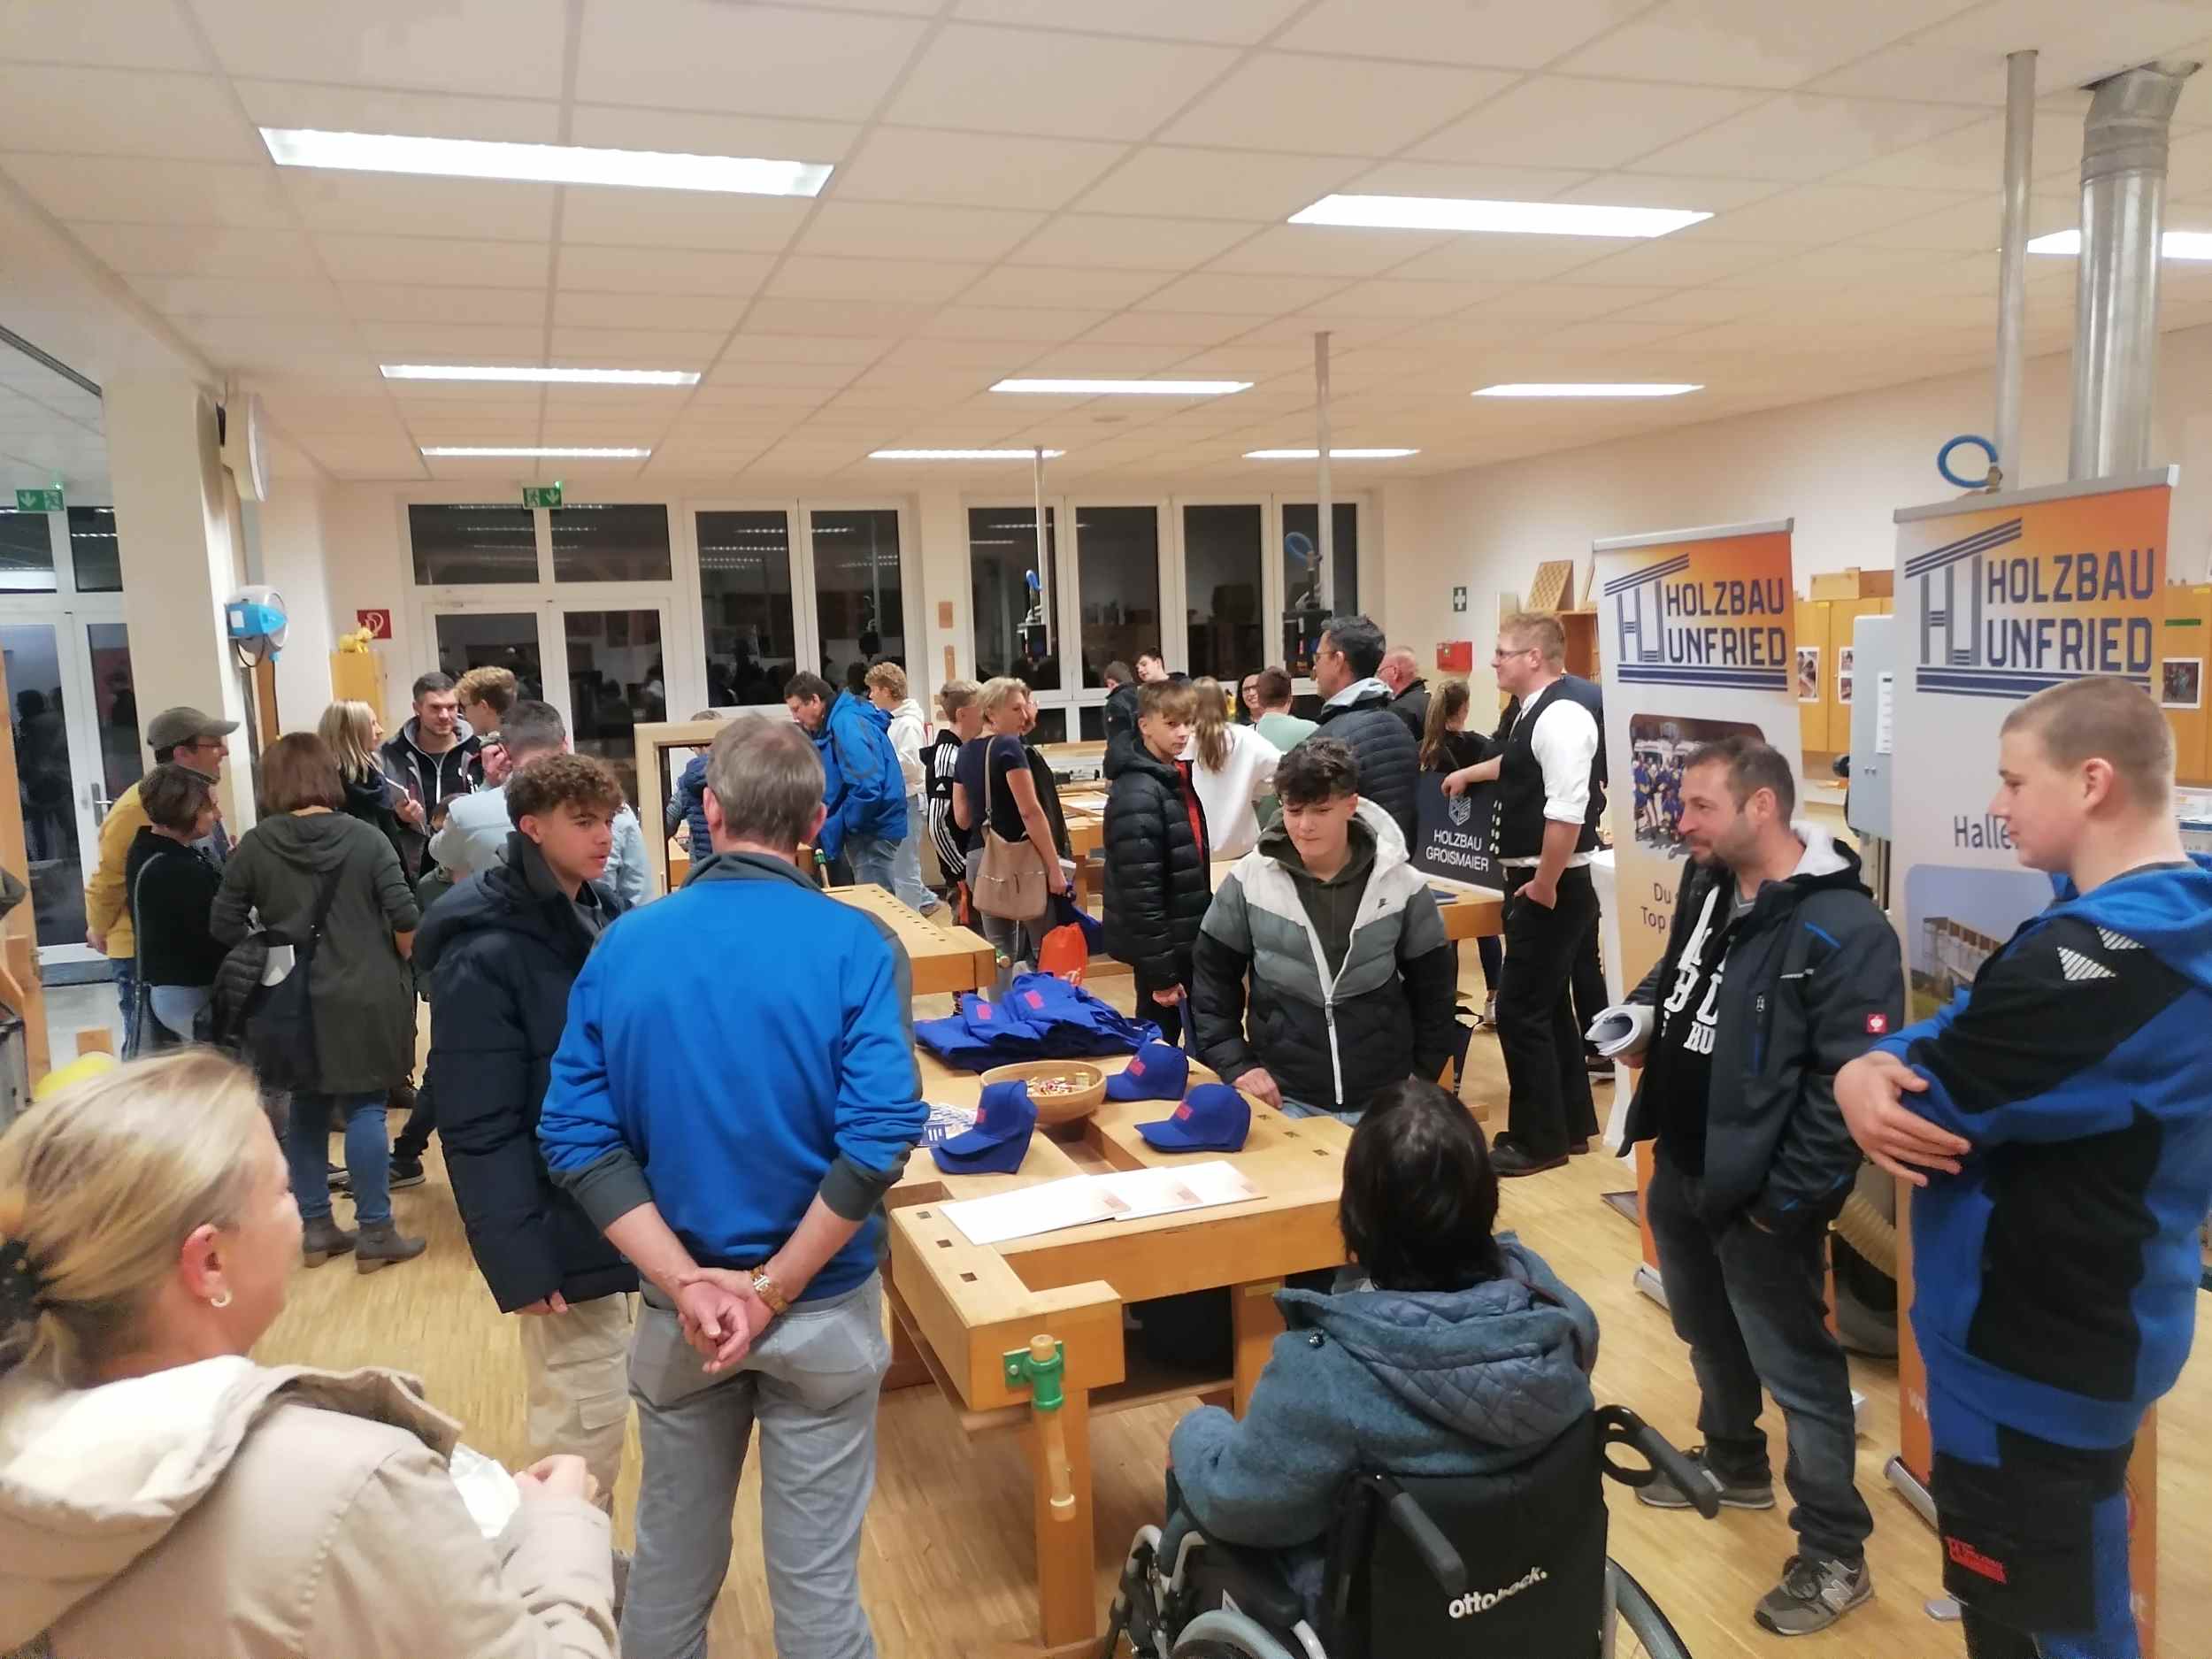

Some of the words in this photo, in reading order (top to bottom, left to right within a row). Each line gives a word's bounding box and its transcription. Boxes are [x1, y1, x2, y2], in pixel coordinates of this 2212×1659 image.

[1986, 548, 2154, 604] HOLZBAU
[1666, 577, 1785, 617] HOLZBAU
[1667, 626, 1787, 666] UNFRIED
[1986, 617, 2153, 673] UNFRIED
[1432, 829, 1482, 851] HOLZBAU
[1425, 846, 1489, 872] GROISMAIER
[1654, 882, 1671, 904] Du
[1640, 905, 1666, 934] Top
